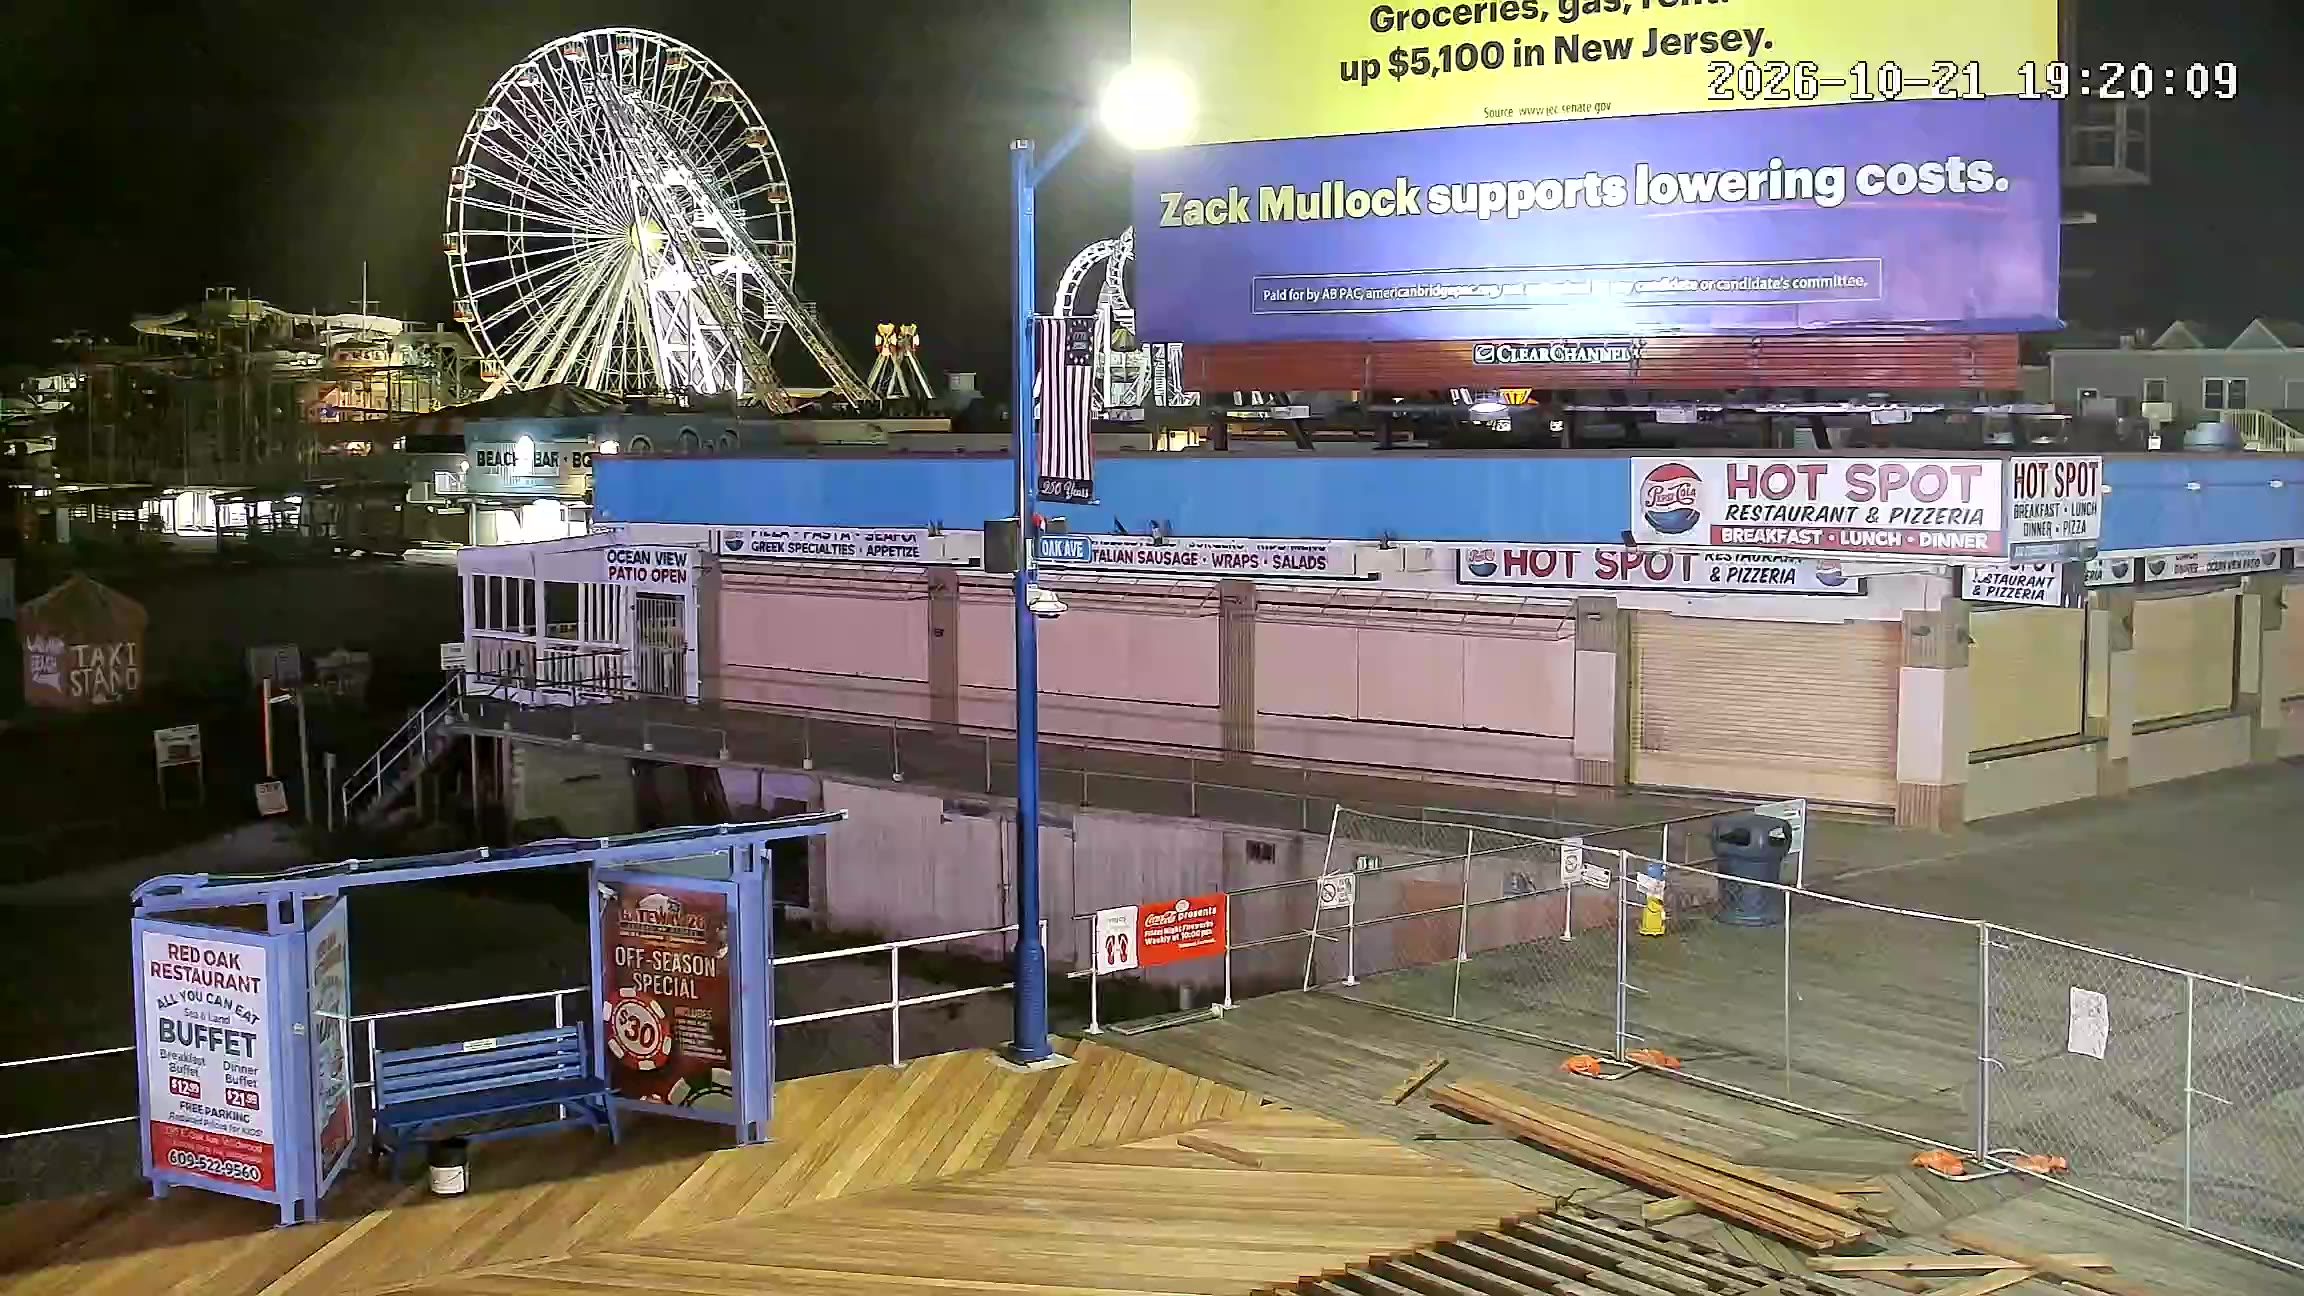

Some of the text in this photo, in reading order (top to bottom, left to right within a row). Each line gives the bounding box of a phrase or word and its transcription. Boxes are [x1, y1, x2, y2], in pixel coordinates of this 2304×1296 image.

[1370, 0, 1630, 33] Groceries, gas,
[1340, 26, 1774, 86] up $5,100 in New Jersey.
[1159, 155, 2010, 229] Zack Mullock supports lowering costs.
[1263, 289, 1287, 302] Paid
[1289, 288, 1304, 301] for
[1306, 288, 1320, 302] by
[1322, 288, 1337, 300] AB
[1700, 281, 1714, 291] or
[534, 450, 560, 467] BAR
[1726, 463, 1983, 503] HOT SPOT
[2013, 461, 2099, 499] HOT SPOT
[1724, 504, 1985, 526] RESTAURANT & PIZZERIA
[2013, 501, 2097, 519] BREAKFAST LUNCH
[1721, 527, 1988, 550] BREAKFAST LUNCH DINNER
[2023, 520, 2087, 537] DINNER PIZZA
[607, 549, 688, 566] OCEAN VIEW
[751, 540, 920, 558] GREEK SPECIALTIES APPETIZE
[1041, 539, 1063, 557] OAK
[1064, 539, 1084, 557] AVE
[1091, 549, 1327, 570] TALIAN SAUSAGE WRAPS SALADS
[608, 566, 687, 584] PATIO OPEN
[1503, 549, 1579, 579] HOT
[1595, 550, 1694, 582] SPOT
[1709, 565, 1797, 584] & PIZZERIA
[1972, 573, 2056, 589] STAURANT
[1972, 584, 2045, 601] & PIZZERIA
[70, 641, 136, 668] TAXI
[70, 667, 138, 697] STAND
[168, 943, 241, 971] RED OAK
[615, 946, 717, 978] OFF-SEASON
[150, 961, 261, 994] RESTAURANT
[632, 972, 699, 1000] SPECIAL
[157, 990, 261, 1025] ALL YOU CAN EAT
[159, 1017, 257, 1059] BUFFET
[618, 1007, 656, 1049] $30
[159, 1049, 206, 1067] Breakfast
[168, 1062, 200, 1077] Buffet
[223, 1060, 259, 1076] Dinner
[225, 1073, 258, 1088] Buffet
[180, 1101, 251, 1124] FREE PARKING
[168, 1148, 262, 1182] 609-522-9560
